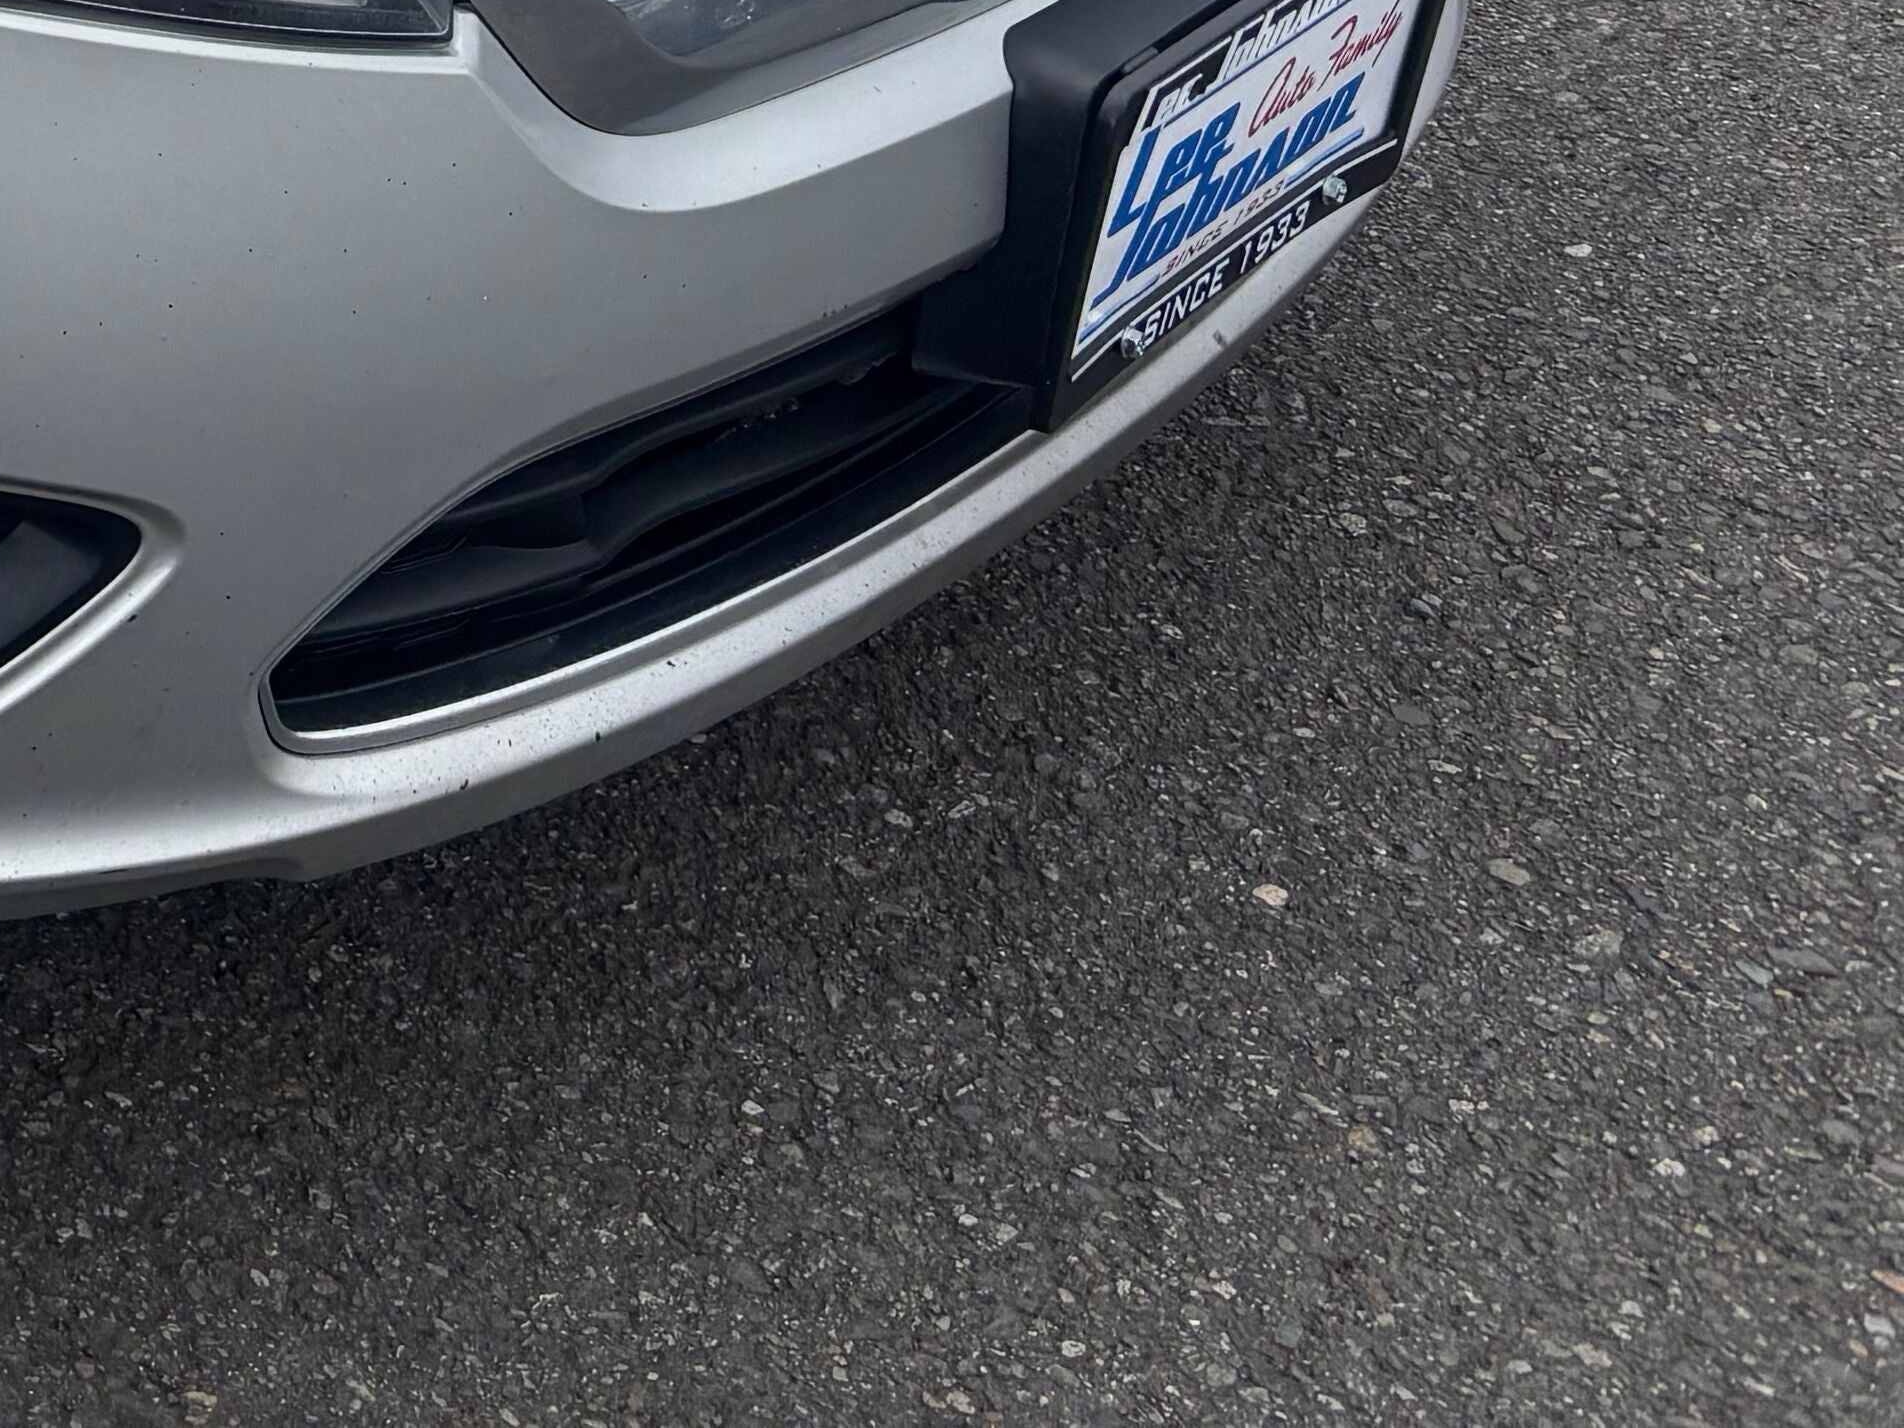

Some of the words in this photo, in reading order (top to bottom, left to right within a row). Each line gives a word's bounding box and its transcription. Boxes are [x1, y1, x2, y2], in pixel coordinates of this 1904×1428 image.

[1247, 56, 1319, 138] Auto
[1089, 70, 1366, 312] Johnson
[1106, 101, 1242, 239] Lee
[1160, 223, 1224, 279] SINCE
[1233, 177, 1285, 226] 1933
[1140, 257, 1232, 344] SINCE
[1239, 200, 1311, 275] 1933
